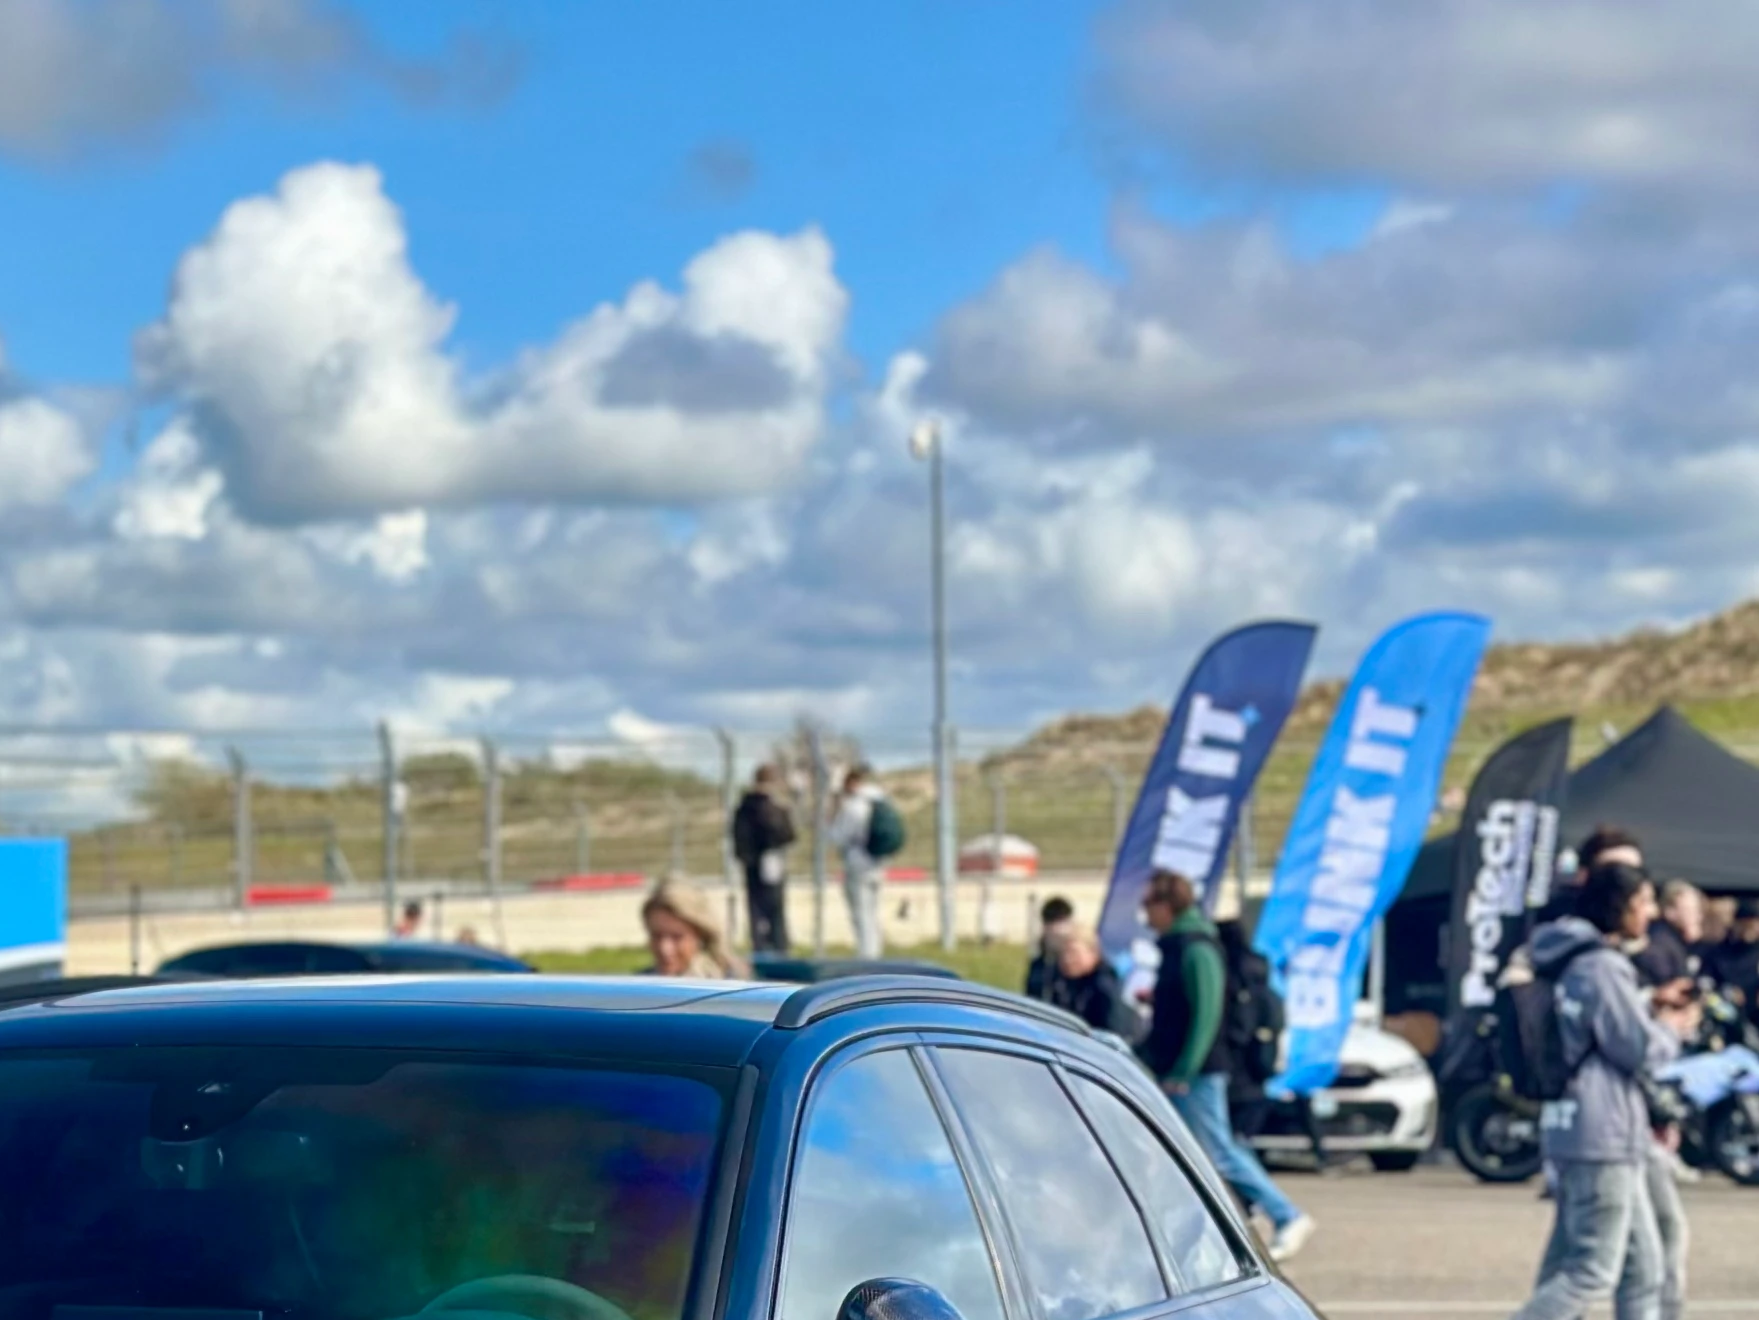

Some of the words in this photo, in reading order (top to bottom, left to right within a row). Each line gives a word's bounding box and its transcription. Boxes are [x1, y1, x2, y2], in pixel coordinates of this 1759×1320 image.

[1177, 693, 1248, 780] IT
[1286, 785, 1397, 1028] BLINK
[1344, 686, 1418, 777] IT
[1460, 799, 1514, 1008] ProTech
